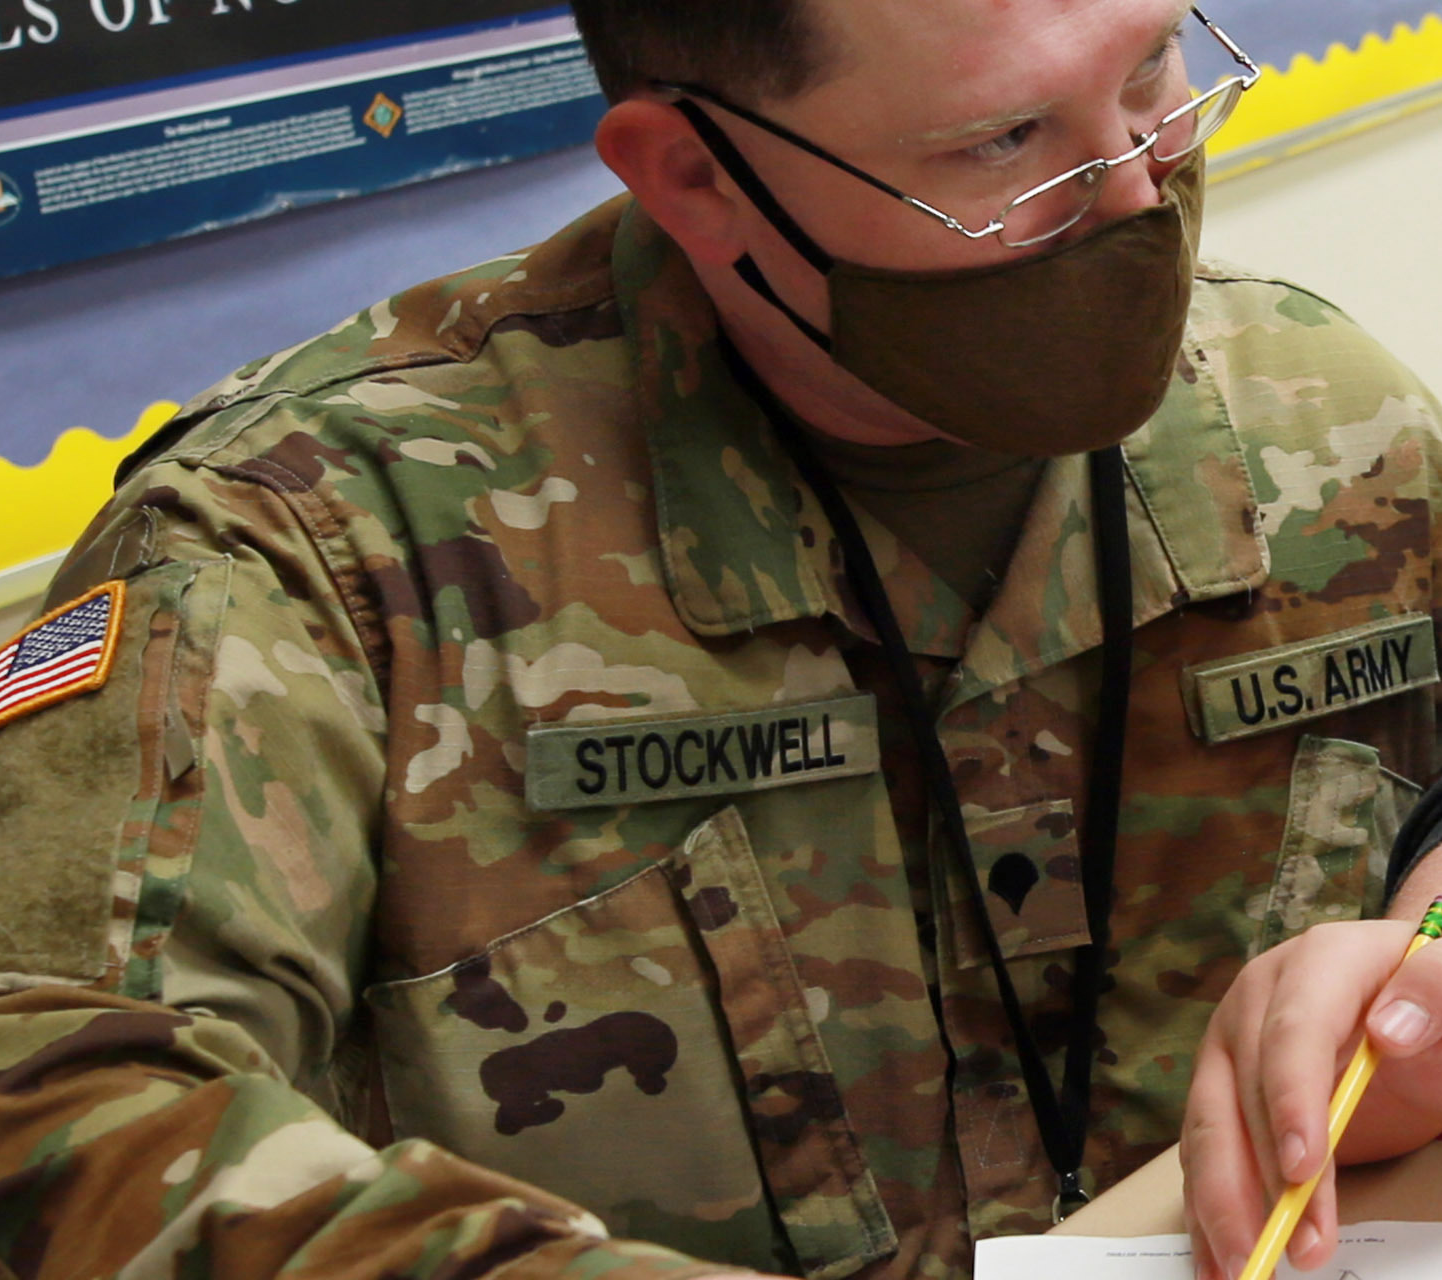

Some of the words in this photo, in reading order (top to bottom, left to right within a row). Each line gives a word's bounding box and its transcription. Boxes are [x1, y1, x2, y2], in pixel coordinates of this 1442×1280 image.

[1231, 664, 1315, 726] U.S.
[1325, 635, 1413, 707] ARMY
[576, 714, 846, 795] STOCKWELL
